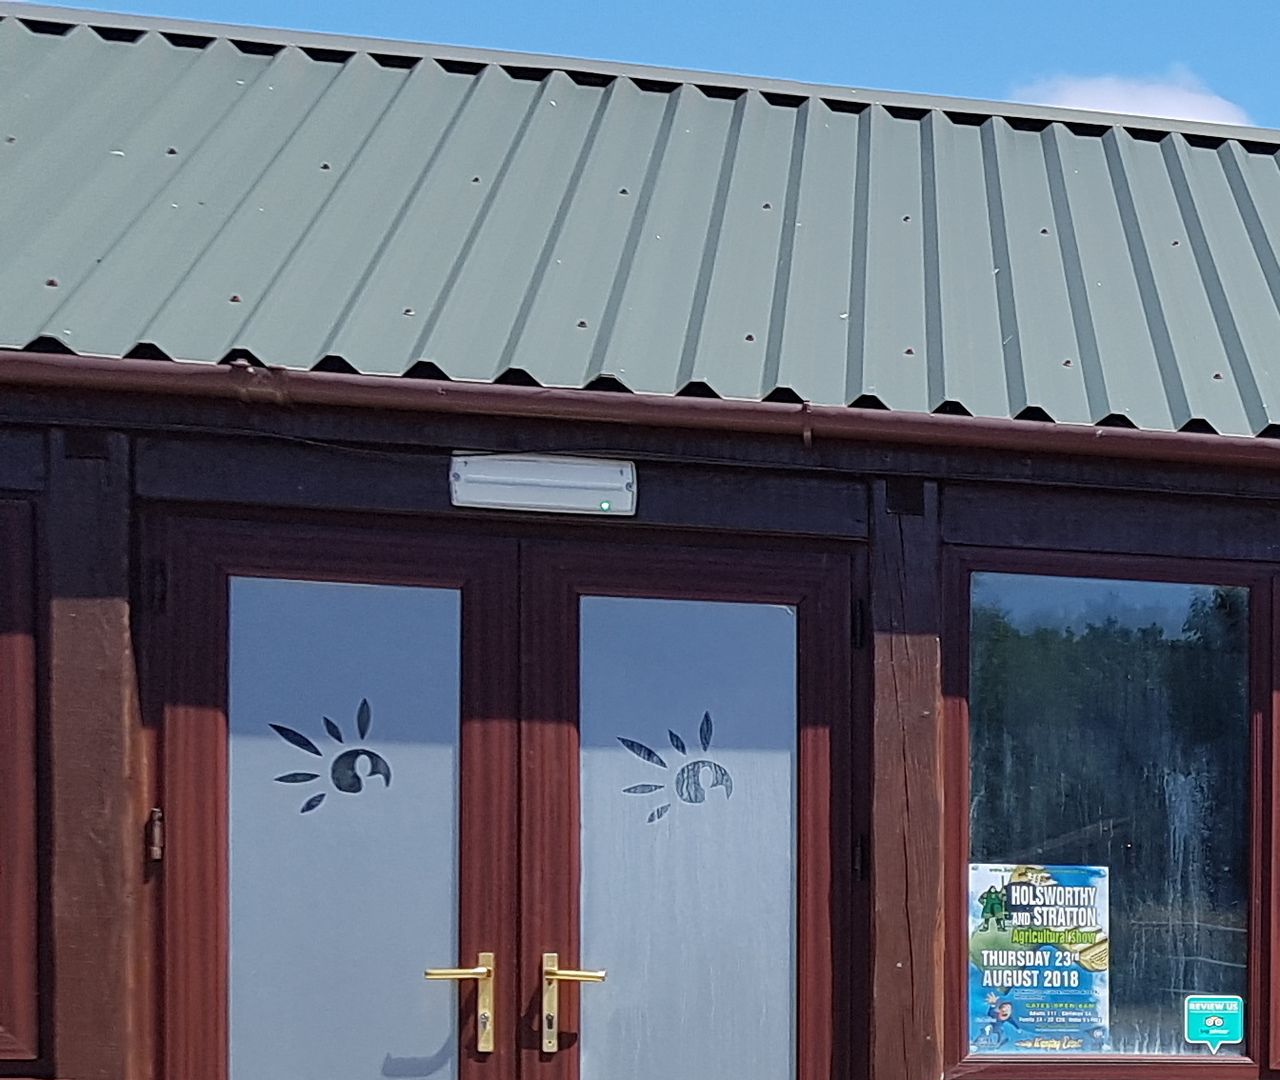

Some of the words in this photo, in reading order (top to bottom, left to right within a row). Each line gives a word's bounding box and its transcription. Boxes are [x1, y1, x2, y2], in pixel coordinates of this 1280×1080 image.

[1011, 885, 1096, 906] HOLSWORTHY
[1011, 912, 1031, 926] AND
[1033, 907, 1096, 927] STRATTON
[1012, 930, 1069, 944] Agricultural
[982, 951, 1050, 967] THURSDAY
[1055, 951, 1079, 967] 23rd
[983, 970, 1039, 987] AUGUST
[1043, 970, 1079, 987] 2018
